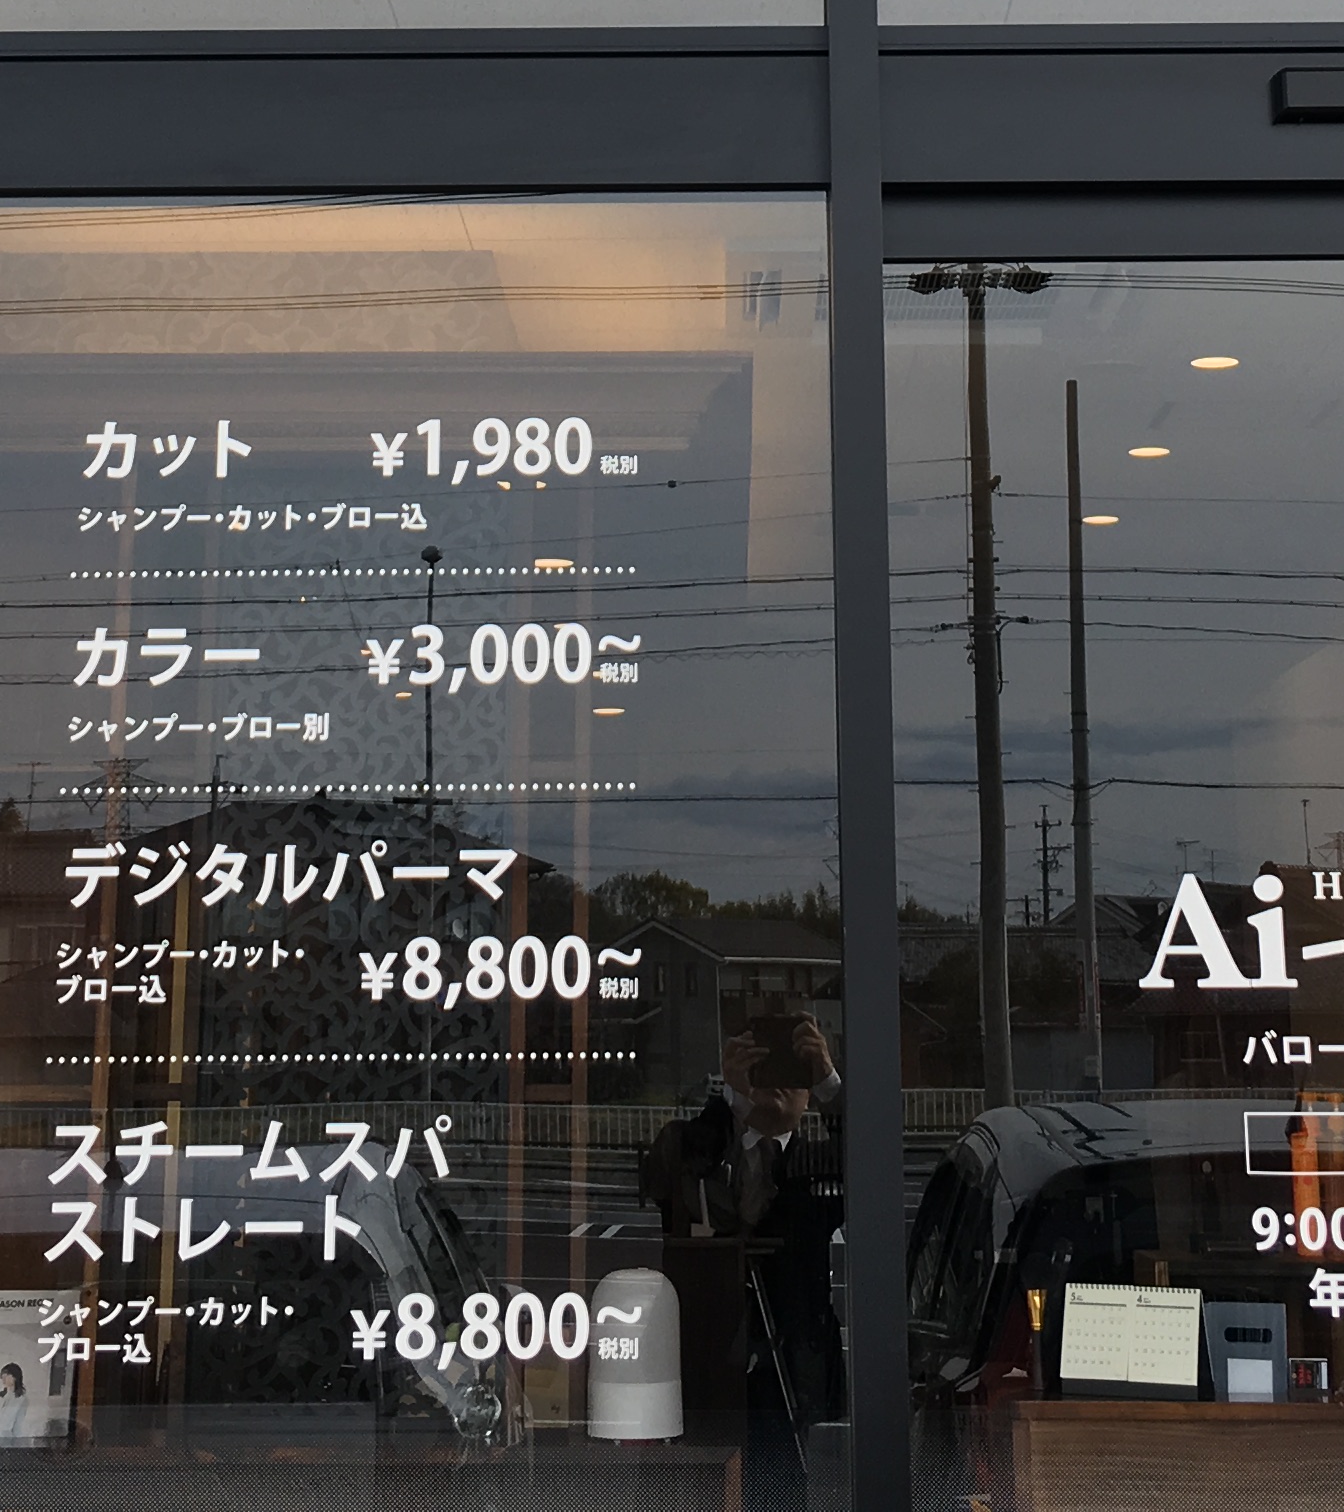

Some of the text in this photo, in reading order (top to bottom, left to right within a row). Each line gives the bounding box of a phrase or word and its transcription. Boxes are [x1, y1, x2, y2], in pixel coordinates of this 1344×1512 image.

[83, 416, 639, 486] カット ¥1,980 税別
[73, 627, 262, 688] カラー
[599, 662, 639, 684] 税別
[64, 839, 519, 909] デジタルパーマ
[55, 974, 168, 1005] ブロー込
[598, 977, 640, 1000] 税別
[47, 1114, 453, 1187] スチームスパ
[42, 1194, 363, 1263] ストレート
[36, 1333, 152, 1365] ブロー込
[597, 1336, 640, 1361] 税別
